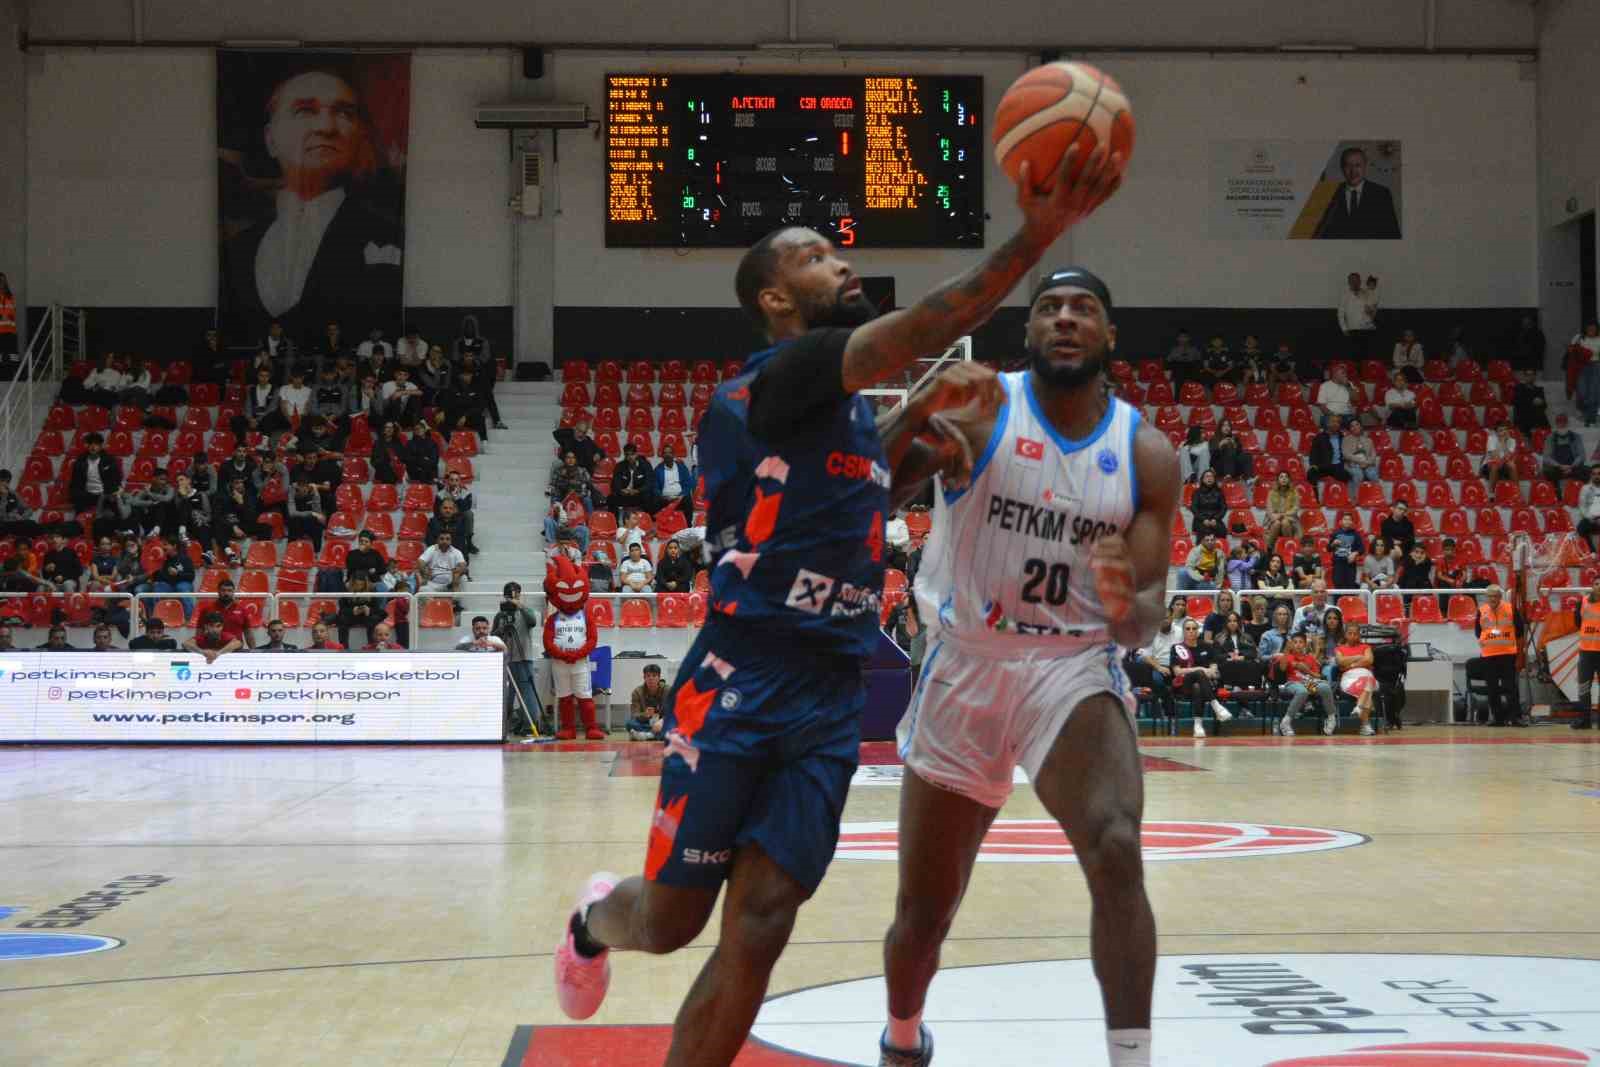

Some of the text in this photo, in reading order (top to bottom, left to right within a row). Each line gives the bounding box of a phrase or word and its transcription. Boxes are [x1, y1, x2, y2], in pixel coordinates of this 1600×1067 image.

[683, 196, 695, 208] 20
[1021, 558, 1070, 606] 20
[11, 669, 156, 683] petkimspor
[197, 669, 461, 683] petkimsporbasketbol
[67, 688, 212, 702] petkimspor
[257, 688, 401, 702] petkimspor
[92, 711, 356, 726] www.petkimspor.org
